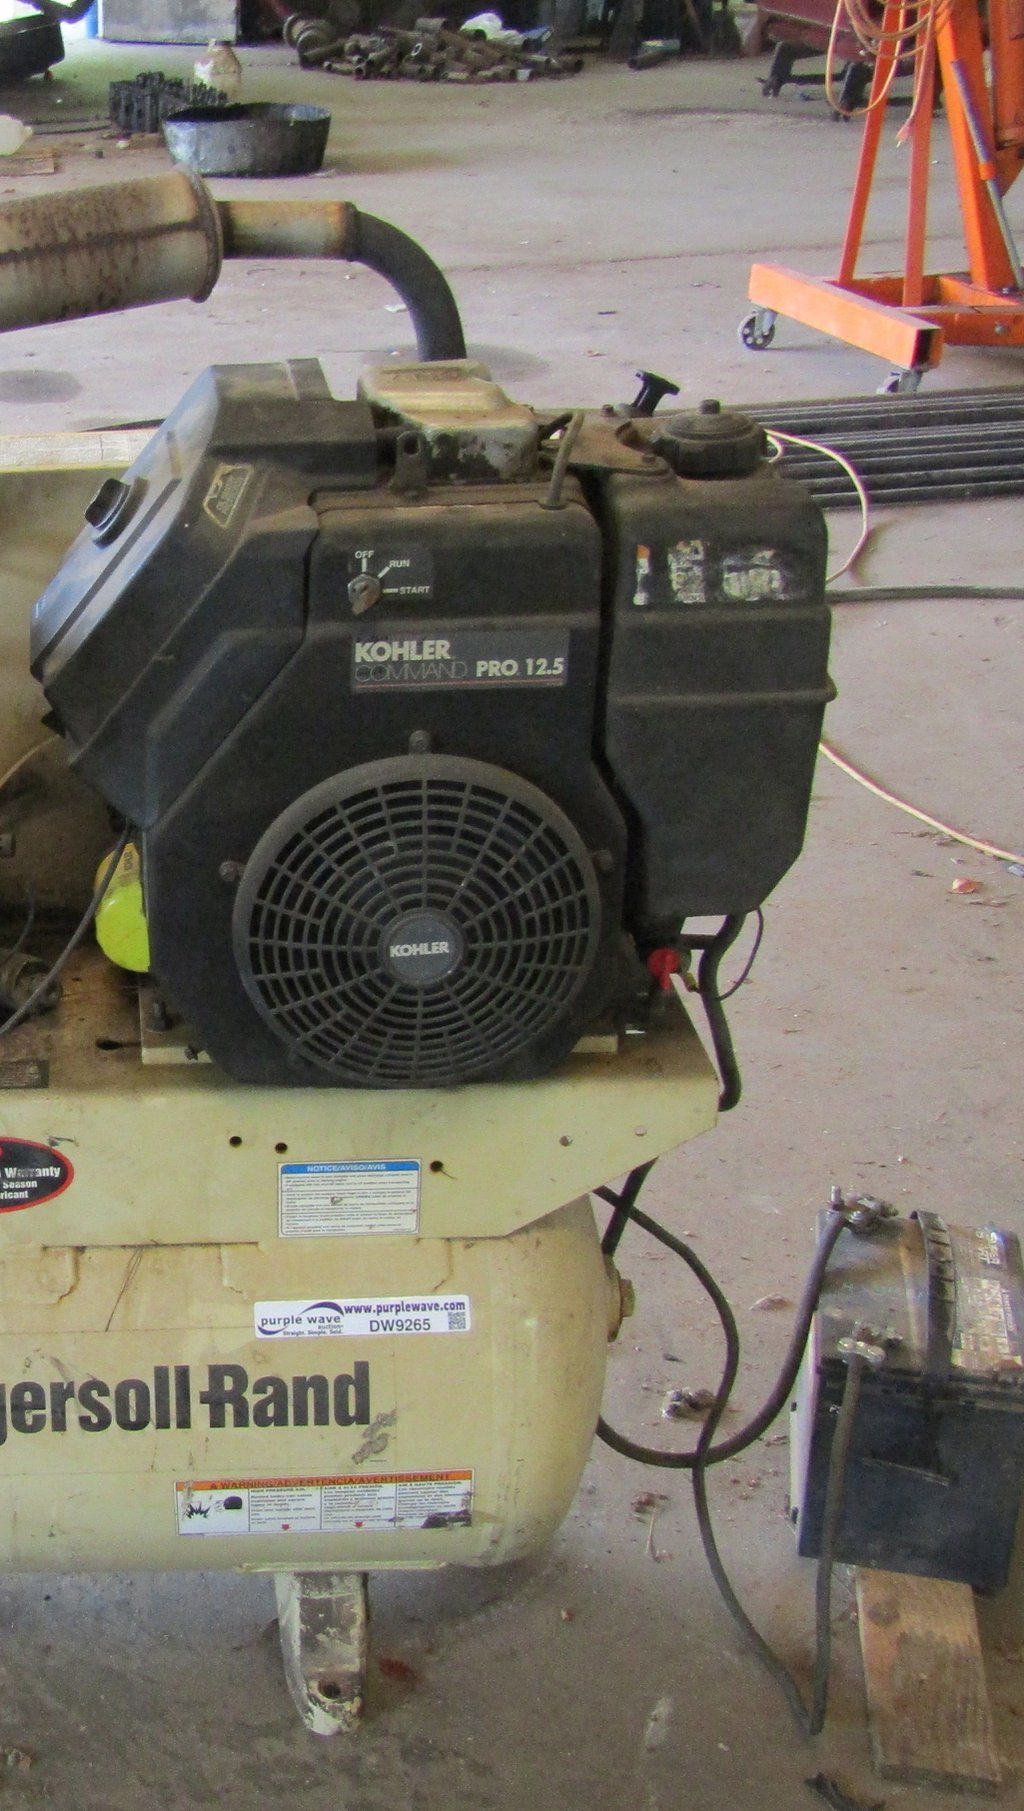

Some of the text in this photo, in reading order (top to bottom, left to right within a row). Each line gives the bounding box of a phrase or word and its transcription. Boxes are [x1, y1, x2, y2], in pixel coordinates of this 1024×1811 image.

[355, 550, 374, 559] OFF
[389, 559, 410, 568] RUN
[399, 585, 430, 594] START
[355, 640, 451, 663] KOHLER
[355, 658, 564, 682] COMMAND PRO 12.5
[389, 941, 449, 957] KOHLER
[3, 1180, 37, 1189] Season
[344, 1301, 465, 1316] www.purplewave.com
[261, 1315, 341, 1327] purple wave
[369, 1318, 431, 1332] DW9265
